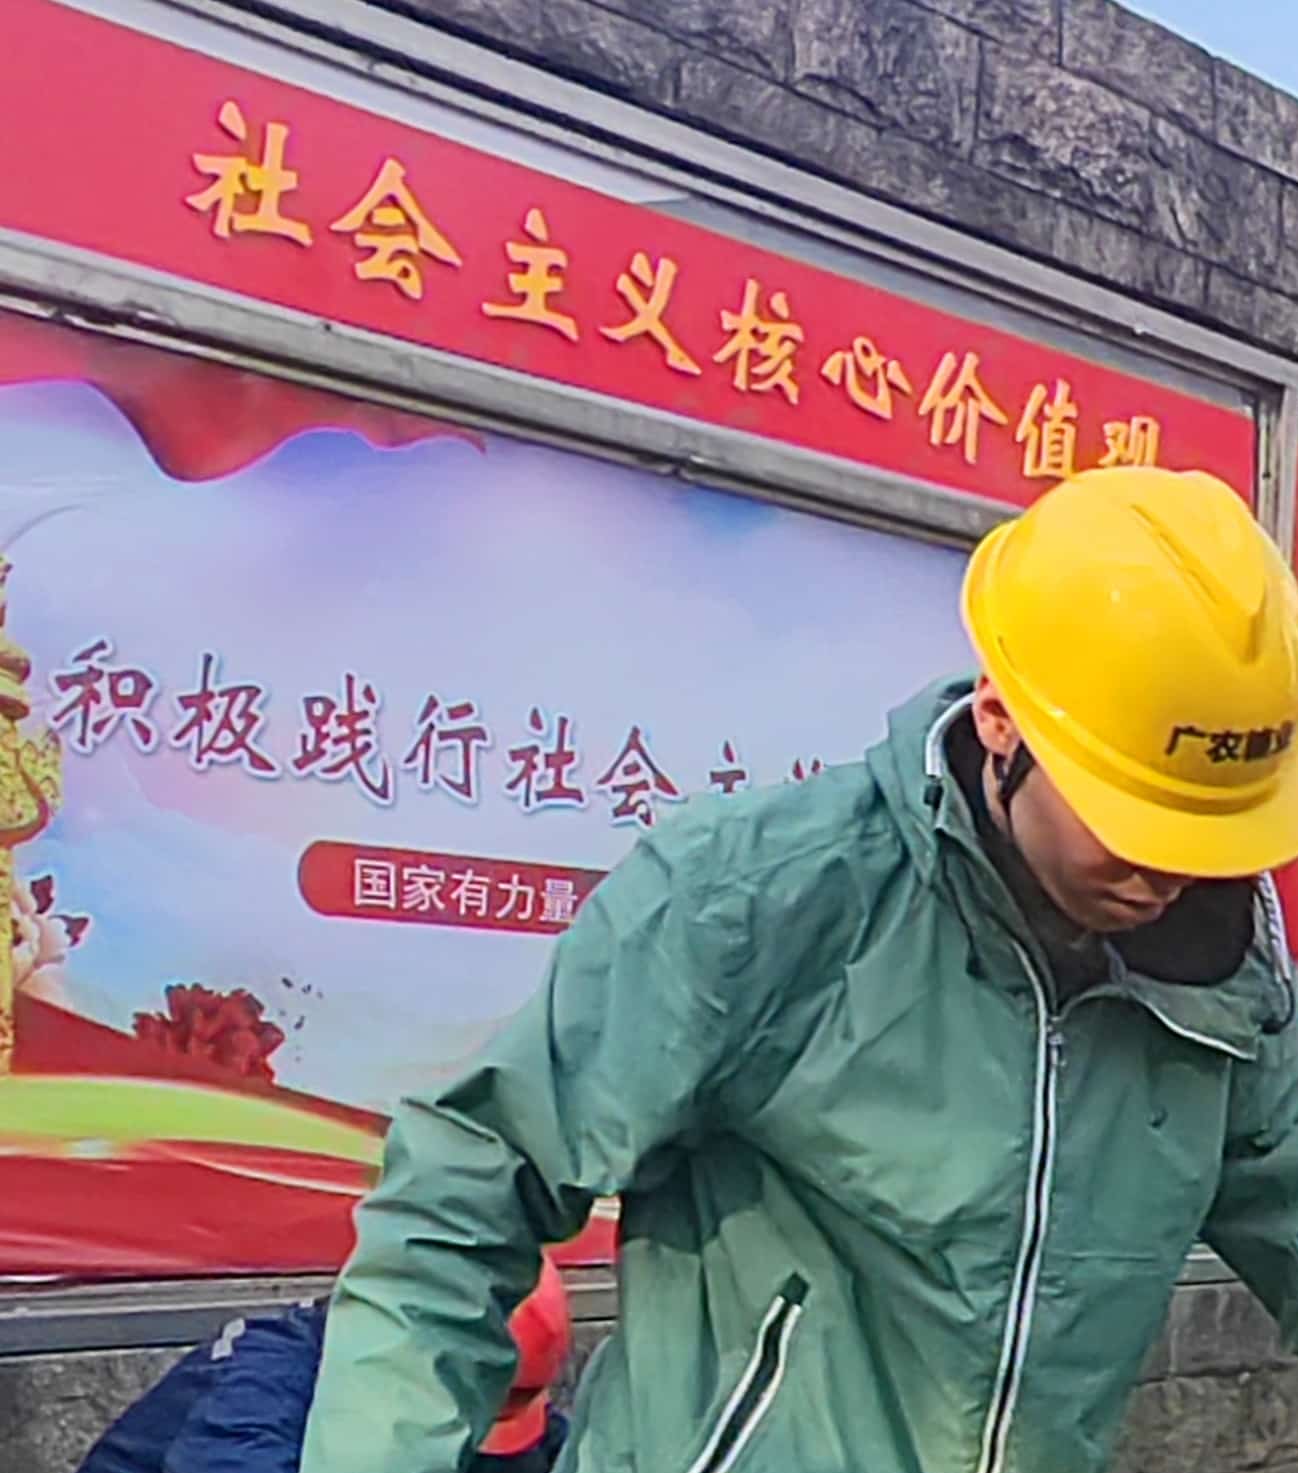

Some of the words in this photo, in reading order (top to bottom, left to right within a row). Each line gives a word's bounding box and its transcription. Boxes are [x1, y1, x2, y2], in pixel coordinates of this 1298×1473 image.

[184, 100, 1161, 478] 社会主义核心价值观
[50, 640, 822, 826] 积极践行社会
[353, 857, 577, 922] 国家有力量
